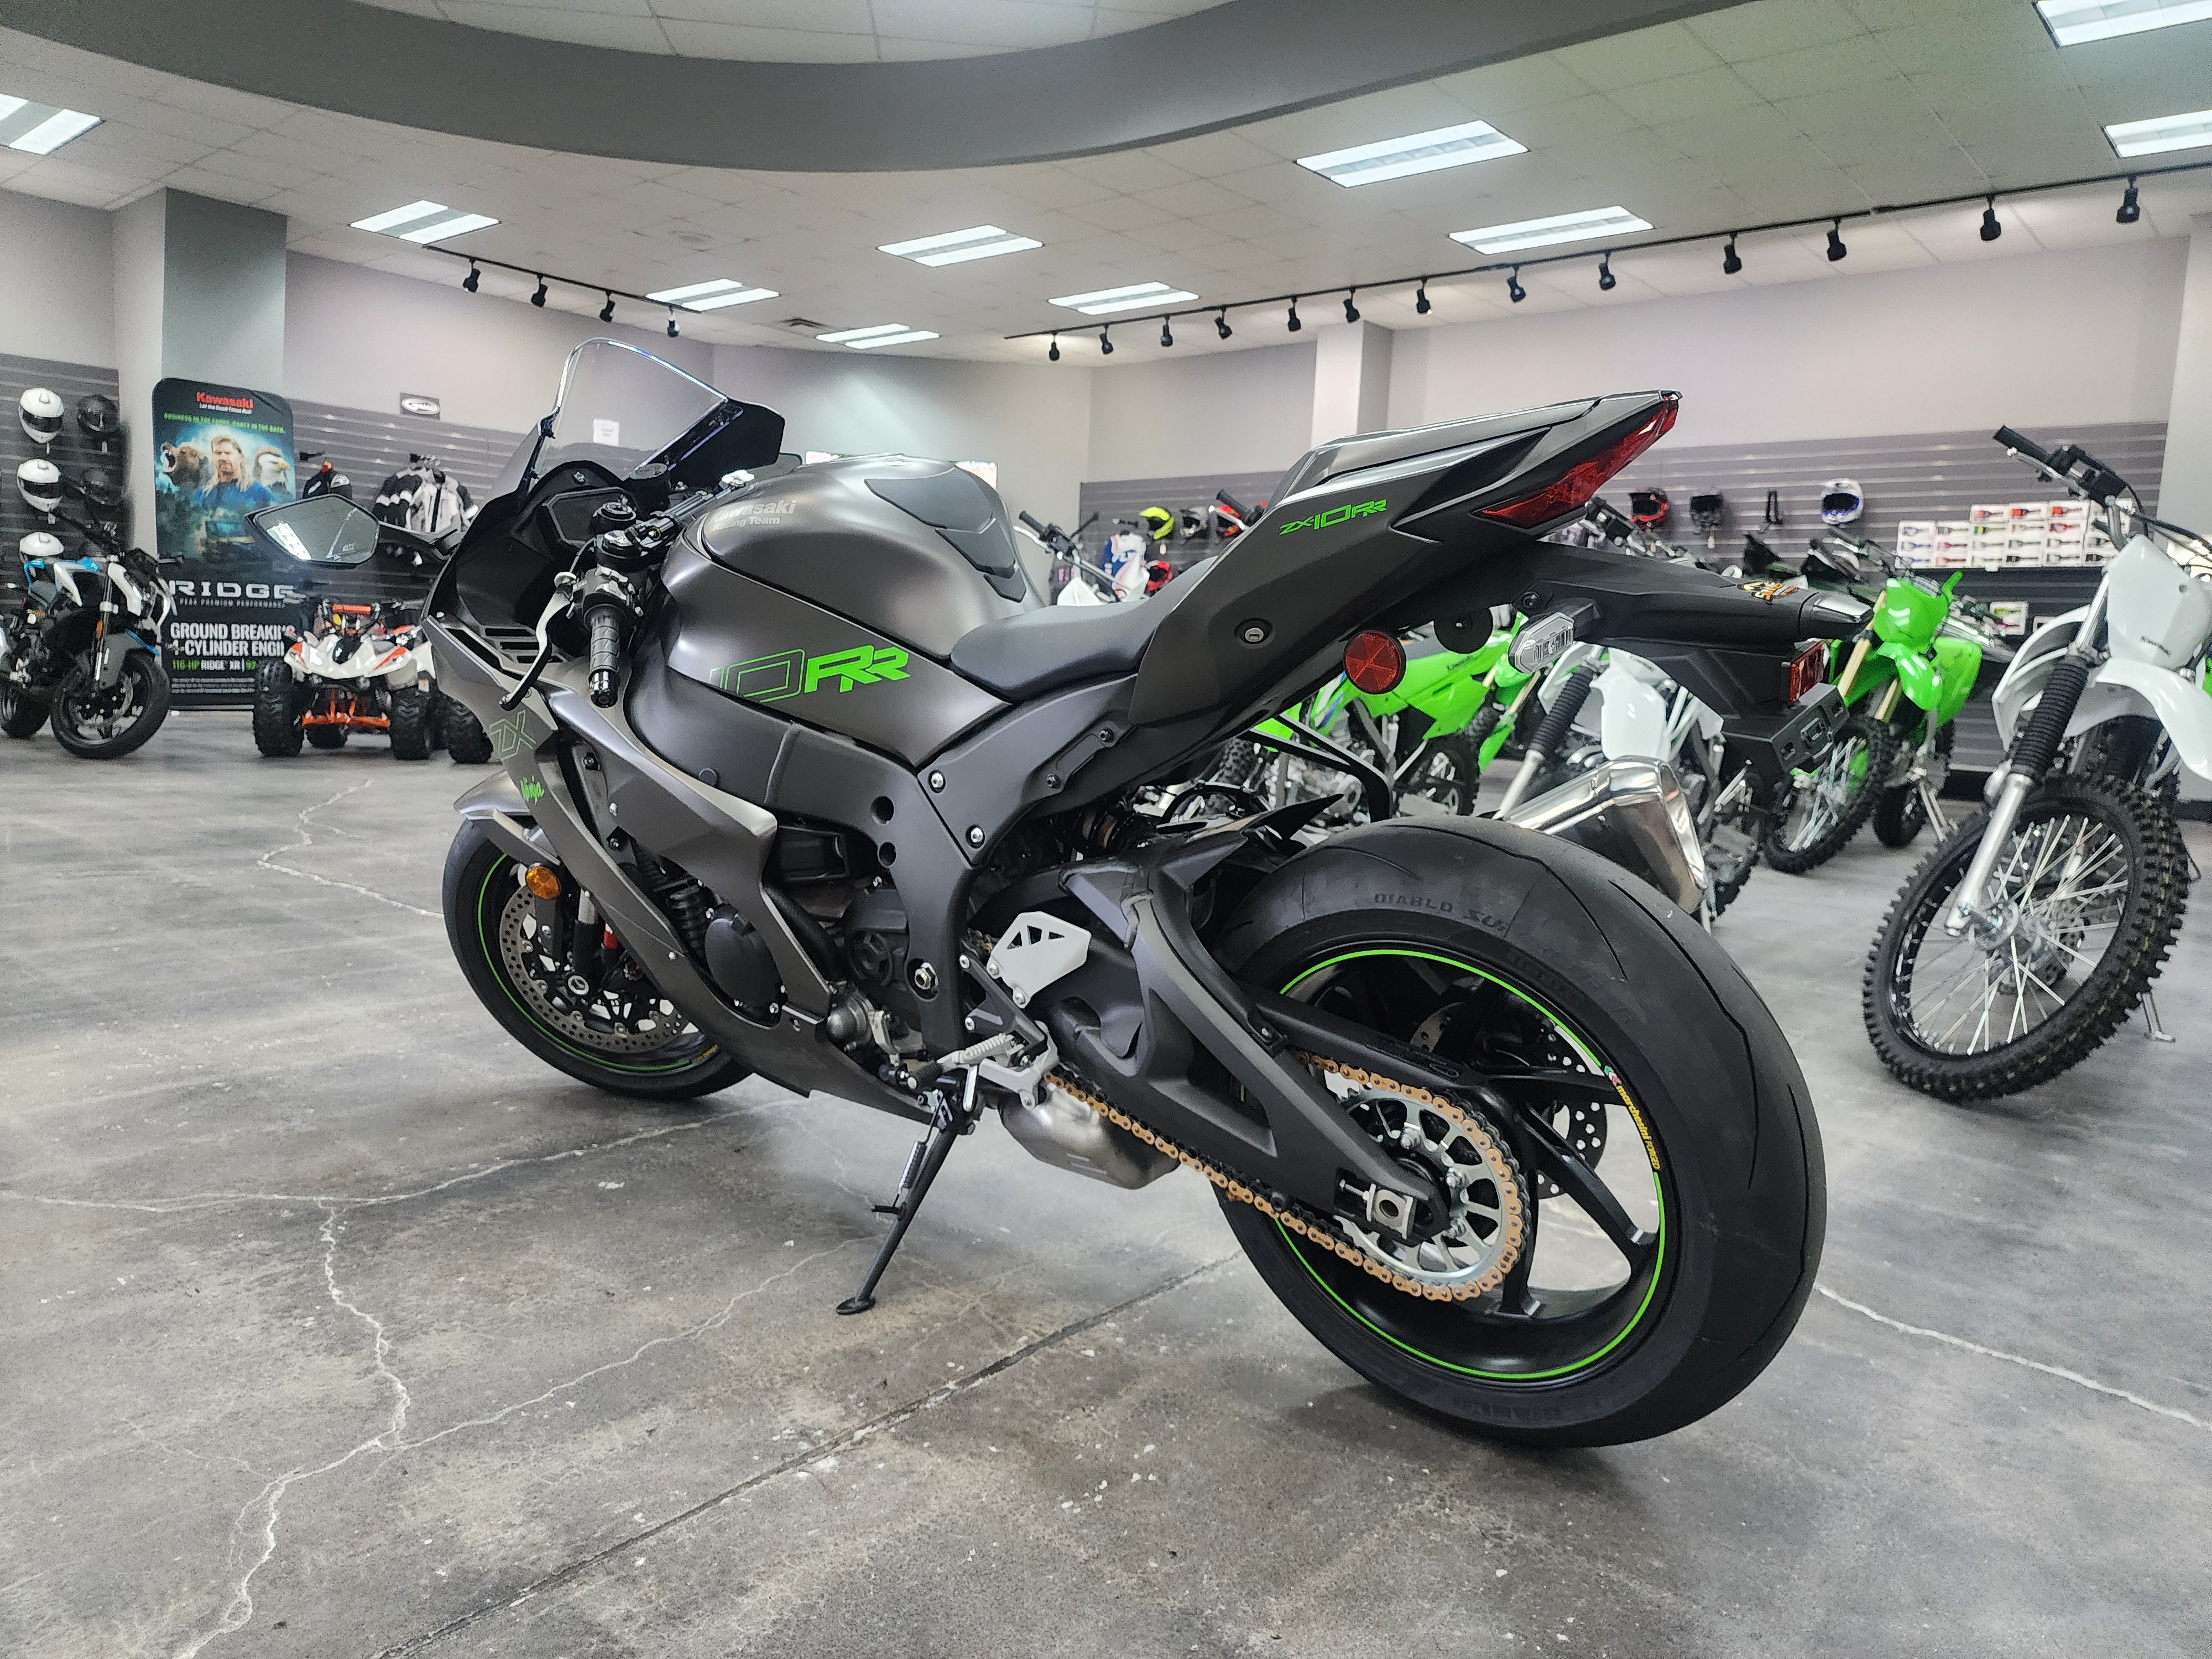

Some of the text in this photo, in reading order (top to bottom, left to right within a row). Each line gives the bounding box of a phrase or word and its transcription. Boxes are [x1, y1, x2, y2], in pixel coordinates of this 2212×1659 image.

[196, 392, 254, 409] Kawasaki
[711, 500, 797, 523] Kawasaki
[712, 517, 781, 532] Racing Team
[169, 580, 296, 599] RIDGE
[170, 622, 228, 640] GROUND
[1374, 893, 1453, 912] DIABLO
